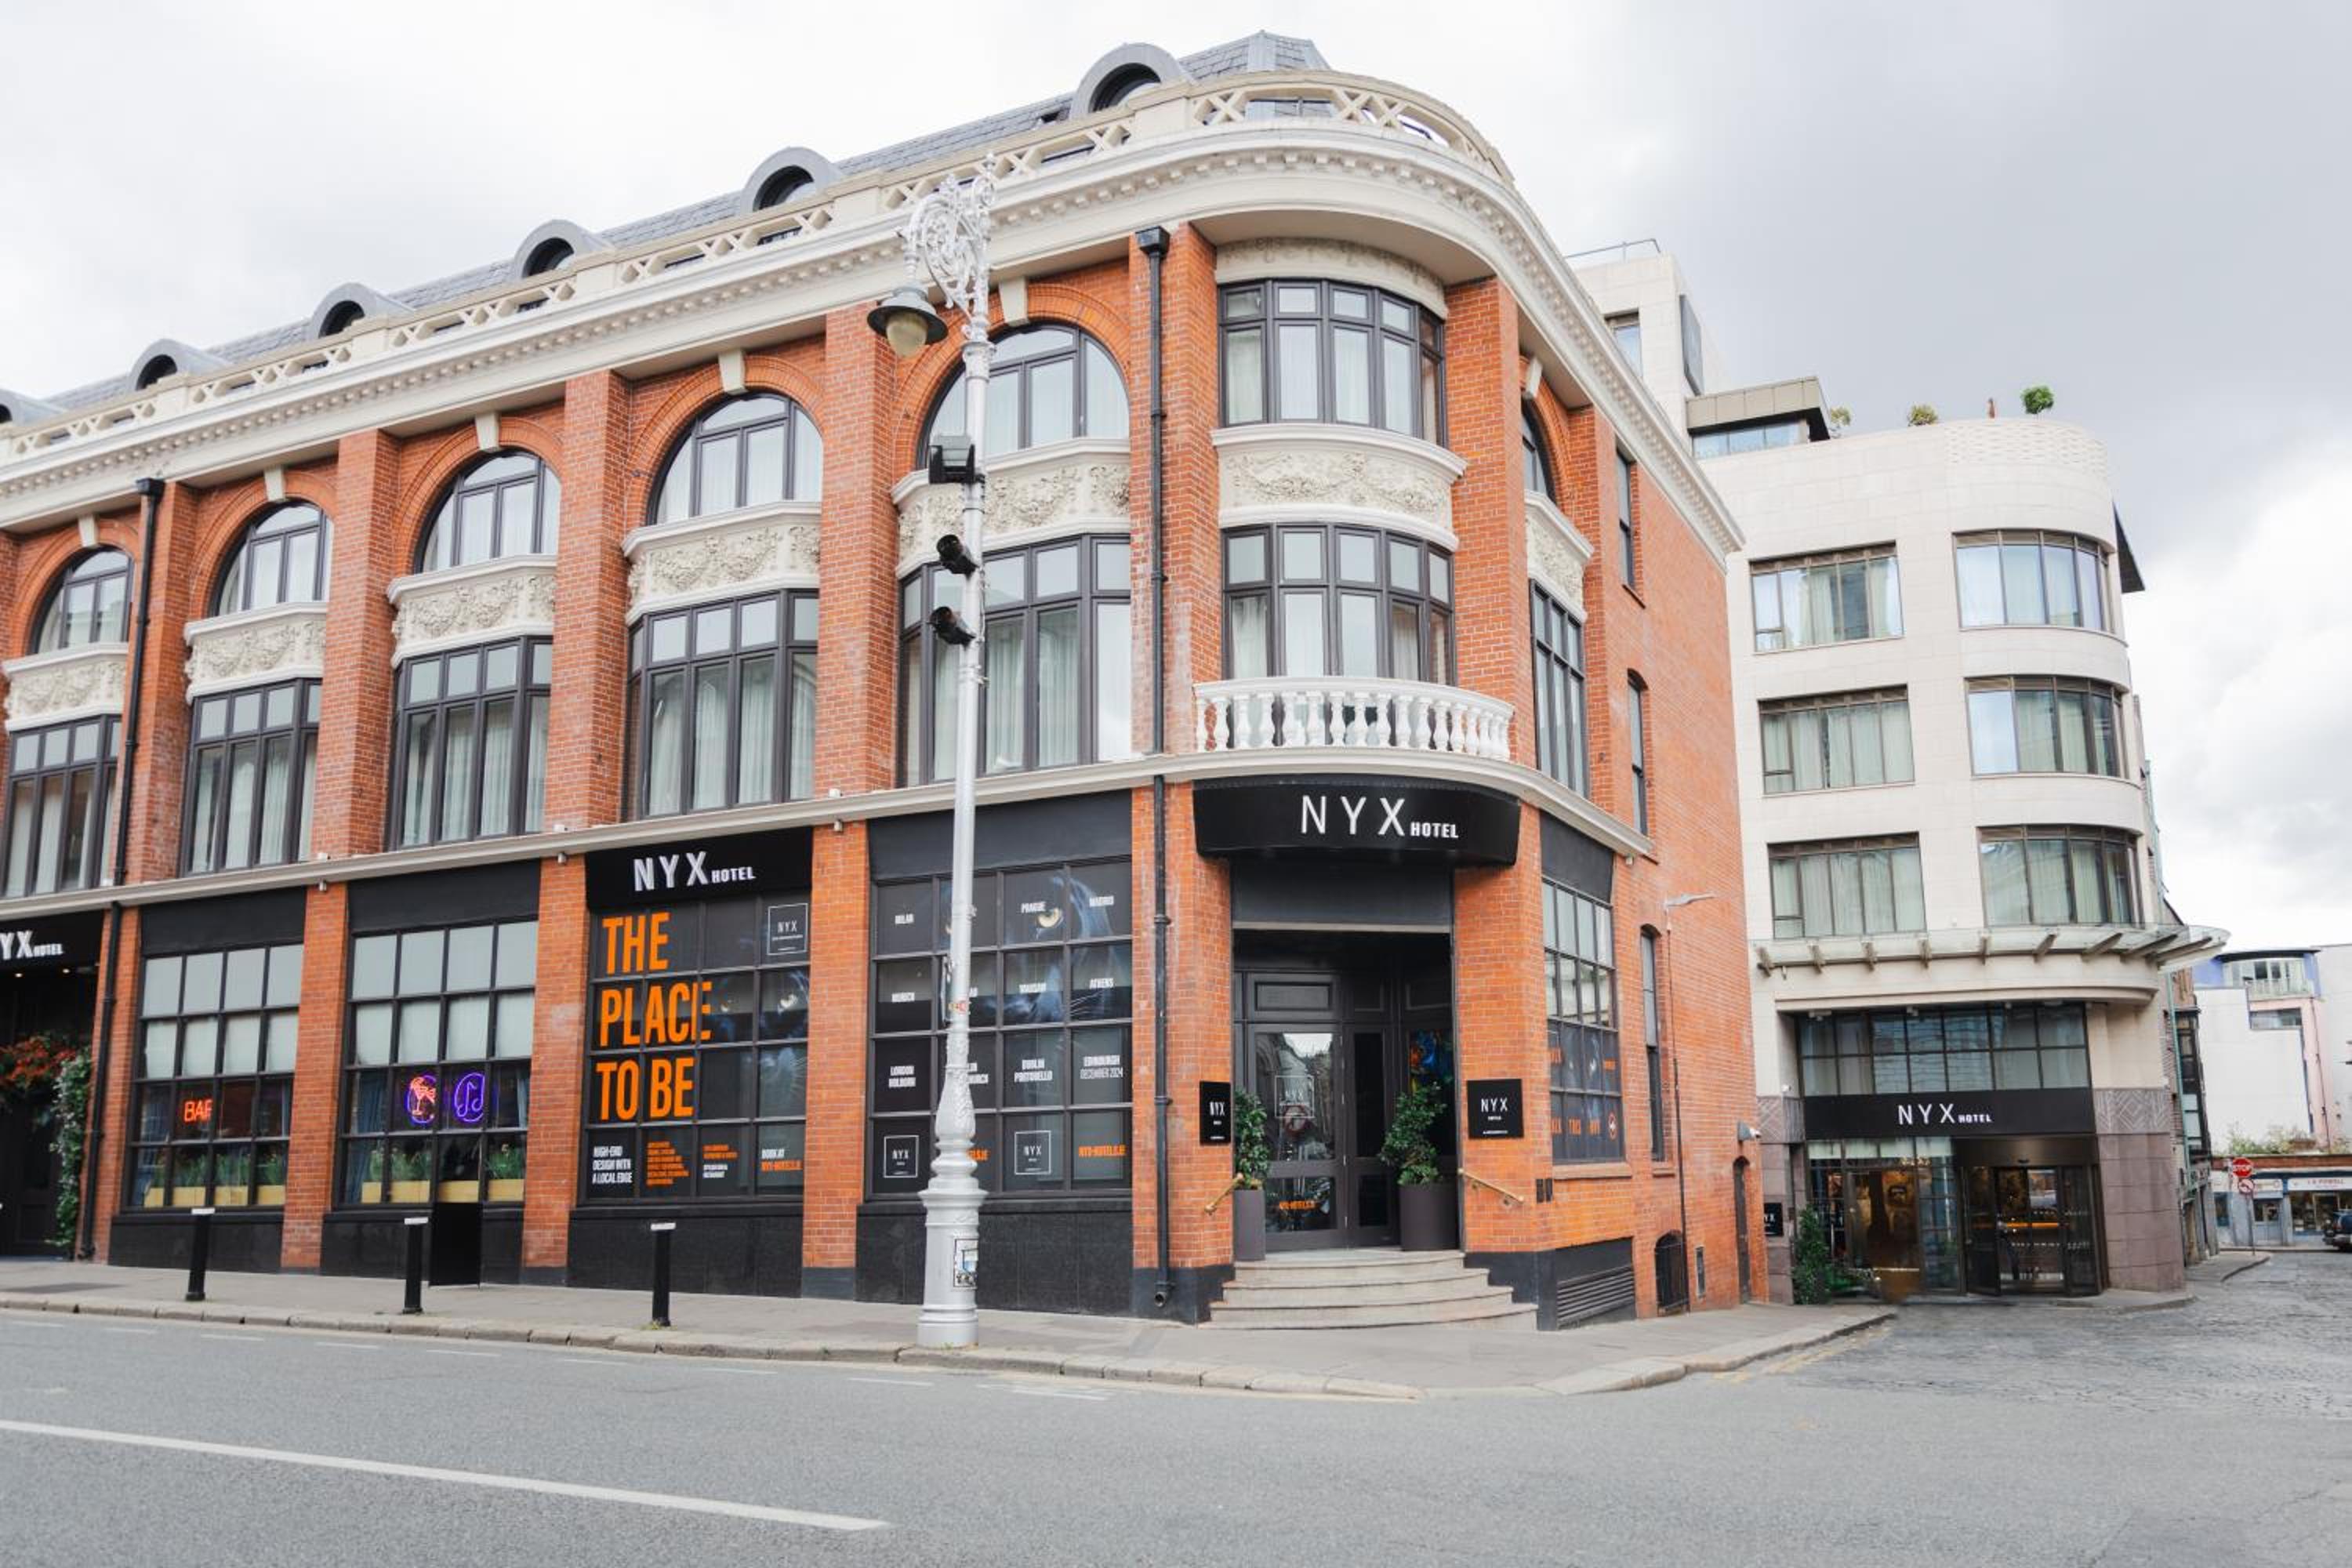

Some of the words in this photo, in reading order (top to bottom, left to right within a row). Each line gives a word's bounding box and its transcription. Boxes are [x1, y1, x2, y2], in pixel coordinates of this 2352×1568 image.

[1301, 794, 1406, 837] NYX
[1410, 822, 1459, 838] HOTEL
[633, 851, 709, 891] NYX
[712, 866, 756, 884] HOTEL
[1021, 901, 1046, 913] PRAGUE
[777, 920, 797, 933] NYX
[0, 930, 33, 960] YX
[34, 943, 64, 957] HOTEL
[601, 911, 672, 975] THE
[1089, 977, 1114, 989] ATHENS
[600, 982, 713, 1047] PLACE
[890, 1065, 915, 1076] LONDON
[1022, 1058, 1045, 1070] DUBLIN
[596, 1058, 641, 1120] TO
[649, 1057, 695, 1117] BE
[184, 1099, 212, 1123] BAR
[1209, 1101, 1225, 1116] NYX
[1481, 1097, 1508, 1112] NYX
[1897, 1103, 1955, 1125] NYX
[1958, 1114, 1992, 1123] HOTEL
[593, 1145, 623, 1158] HIGH-END
[892, 1149, 909, 1160] NYX
[1023, 1145, 1042, 1156] NYX
[593, 1160, 615, 1171] DESIGN
[615, 1158, 631, 1171] WITH
[597, 1172, 615, 1184] LOCAL
[617, 1171, 633, 1183] EDGE
